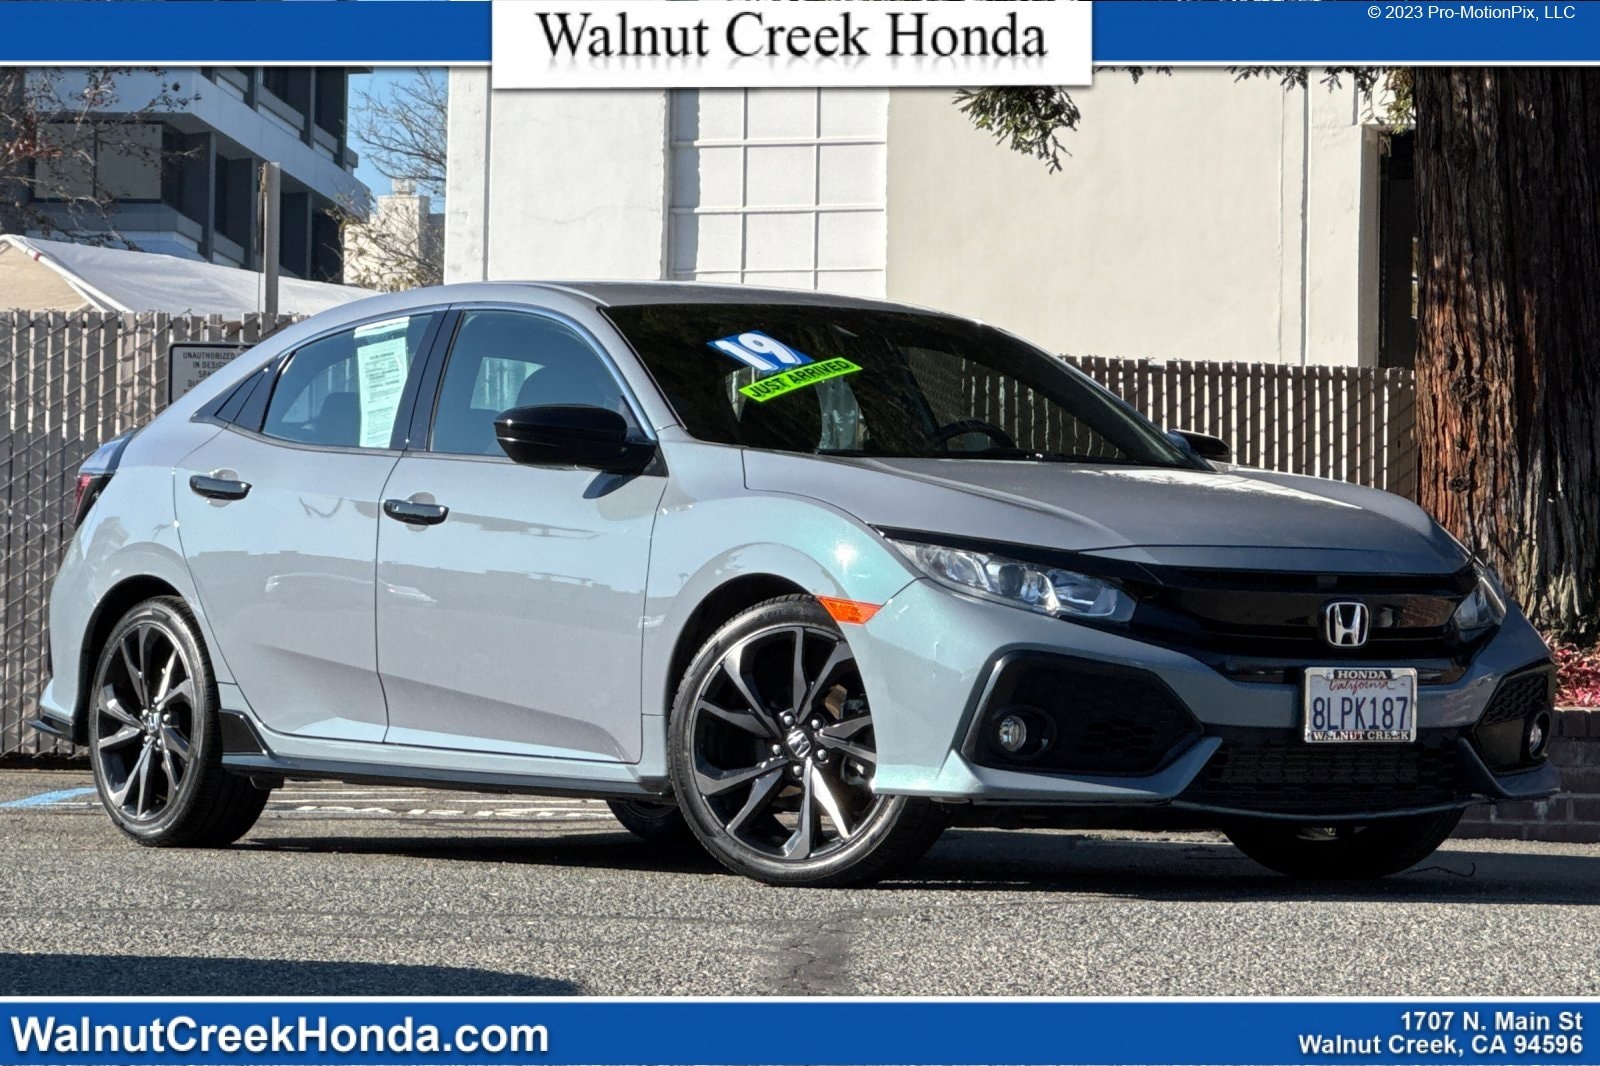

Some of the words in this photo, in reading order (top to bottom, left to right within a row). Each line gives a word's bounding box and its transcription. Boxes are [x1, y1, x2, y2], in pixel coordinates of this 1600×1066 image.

[182, 351, 236, 360] UNAUTHORIZED
[714, 332, 802, 371] 19
[193, 361, 200, 369] IN
[749, 377, 786, 398] JUST
[788, 360, 850, 384] ARRIVED
[1337, 670, 1388, 680] HONDA
[1329, 680, 1396, 696] California
[1312, 696, 1409, 730] 8LPK187
